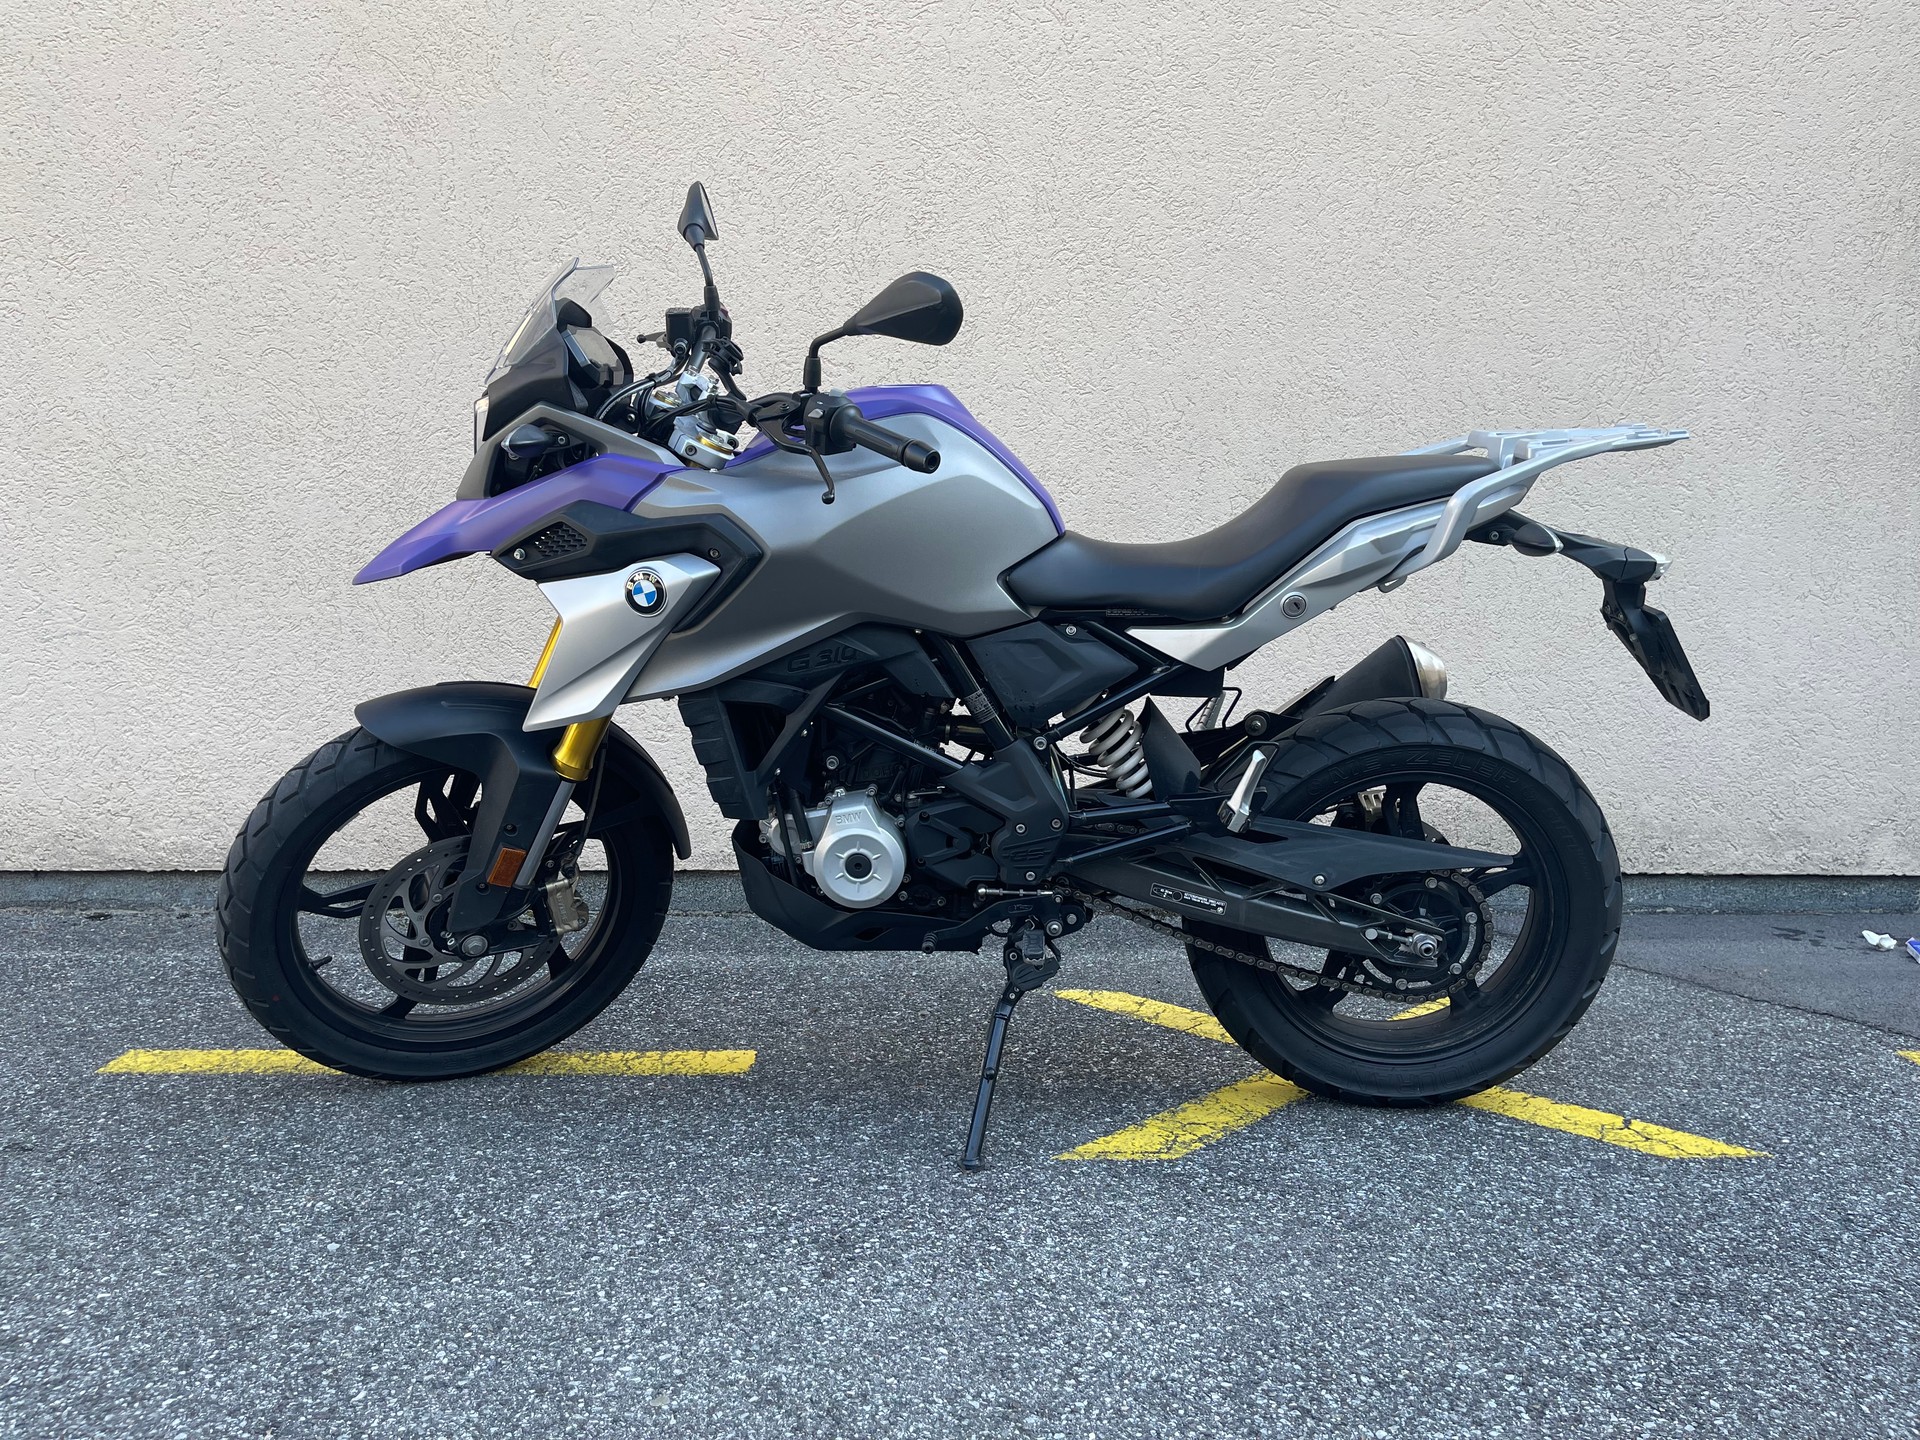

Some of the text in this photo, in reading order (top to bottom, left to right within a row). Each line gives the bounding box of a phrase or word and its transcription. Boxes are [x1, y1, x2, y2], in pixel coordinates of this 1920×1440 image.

[626, 572, 657, 590] BMW
[787, 645, 857, 673] G 310
[835, 811, 862, 825] BMW
